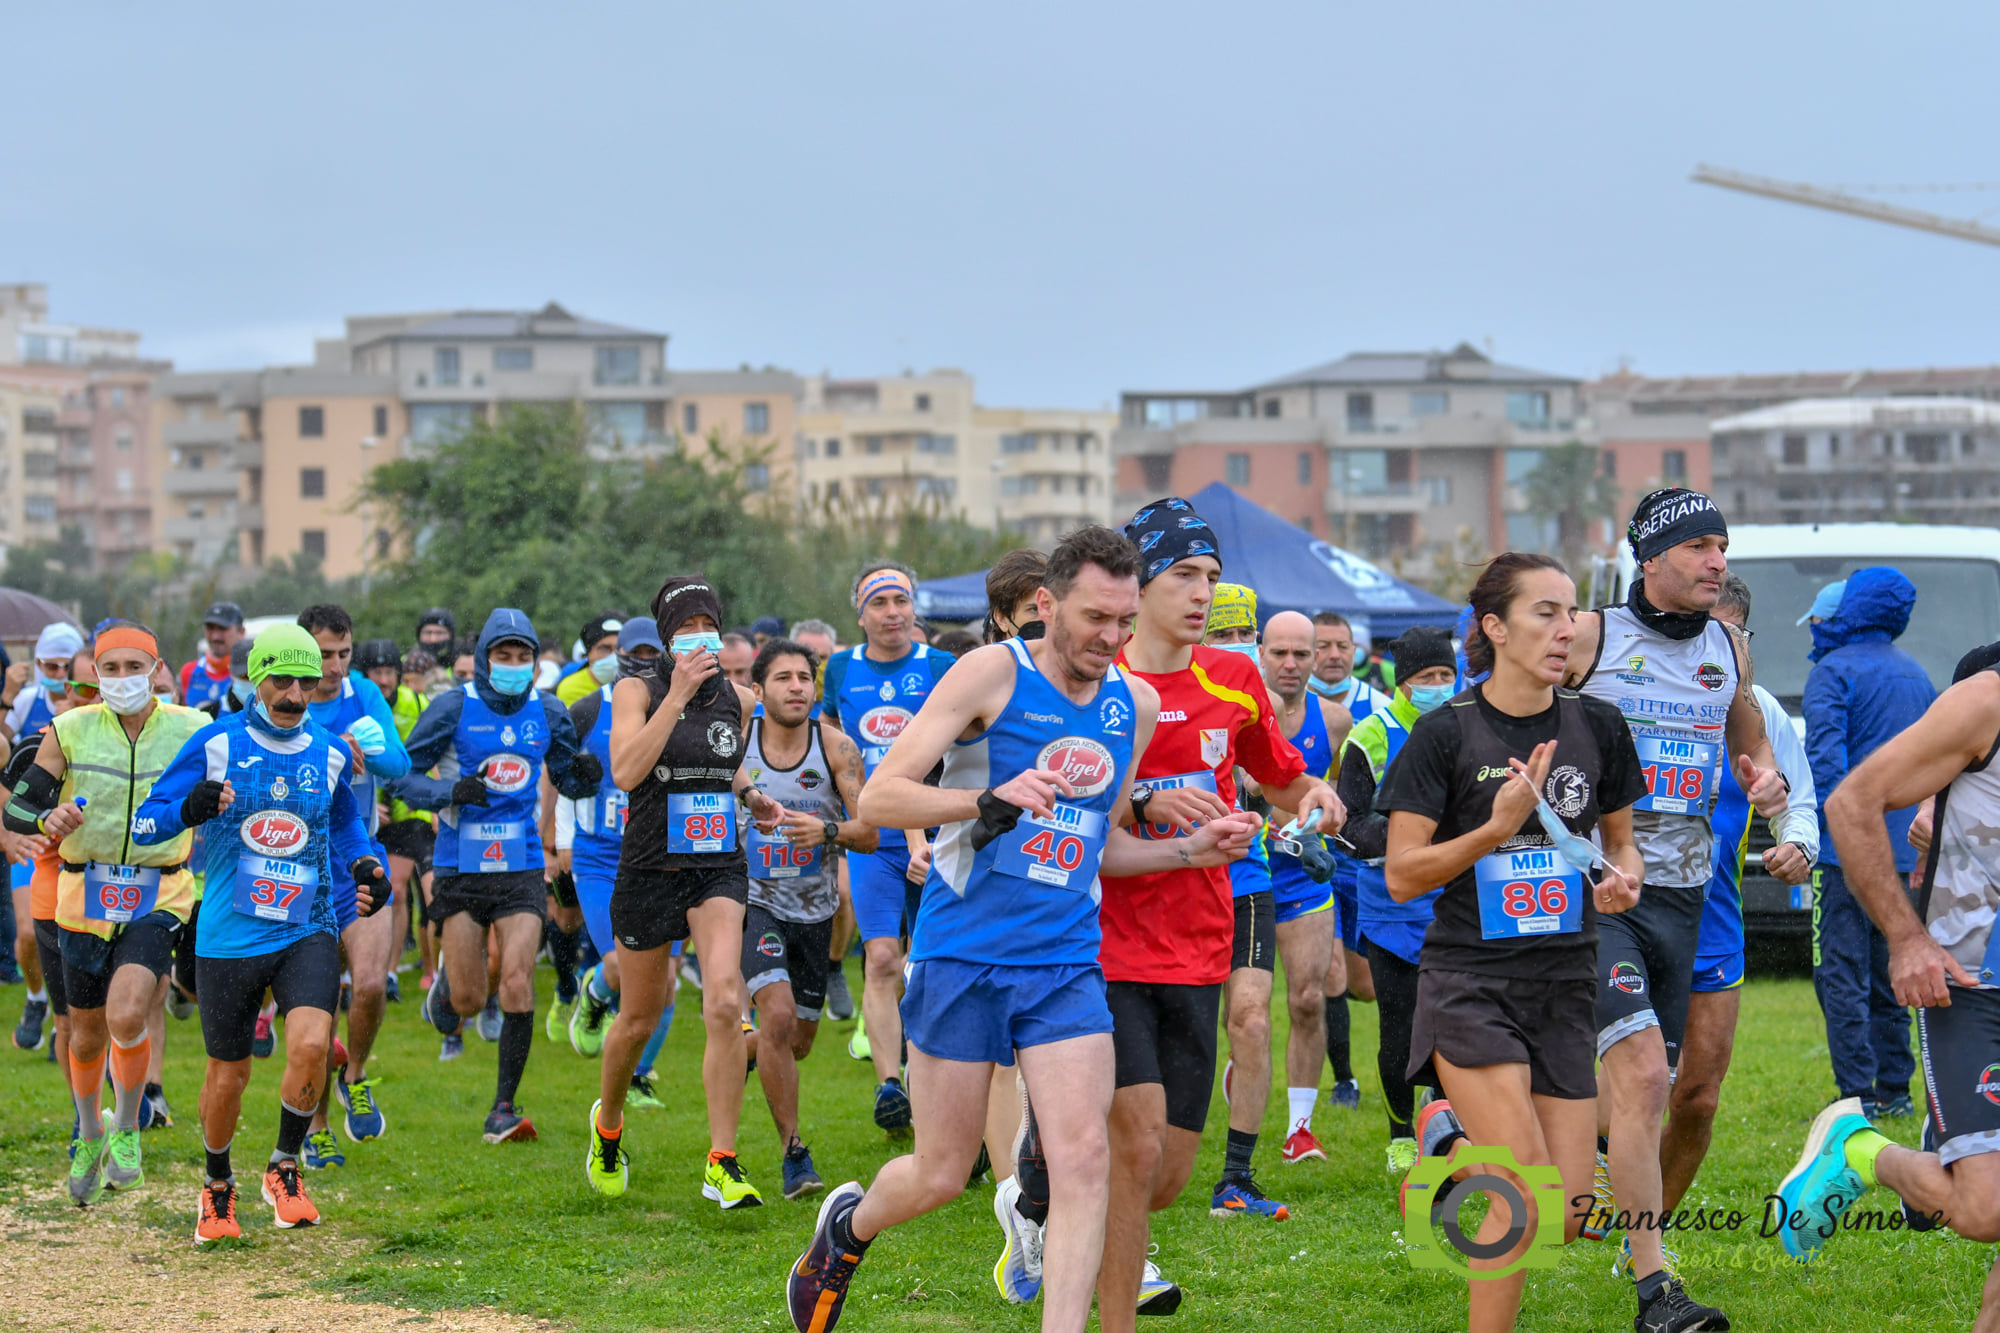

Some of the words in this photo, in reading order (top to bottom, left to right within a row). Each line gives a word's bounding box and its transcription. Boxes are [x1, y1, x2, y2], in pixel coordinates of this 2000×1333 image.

[1692, 673, 1728, 682] EVOLUTION
[1024, 711, 1064, 725] macron
[1157, 709, 1188, 722] ma
[1640, 698, 1695, 717] ITTICA
[1700, 704, 1726, 718] SUD
[871, 712, 908, 736] Sigel
[1630, 725, 1667, 737] AZARA
[1669, 729, 1689, 738] DEL
[1659, 740, 1695, 758] MBI
[486, 759, 524, 784] Sigel
[1057, 746, 1105, 783] Sigel
[1641, 764, 1703, 799] 118
[693, 794, 719, 808] MBI
[252, 817, 298, 846] Sigel
[479, 823, 507, 836] MBI
[684, 813, 727, 840] 88
[483, 840, 505, 861] 4
[757, 844, 814, 867] 116
[1020, 830, 1084, 871] 40
[1511, 852, 1553, 871] MBI
[264, 859, 297, 877] MBI
[99, 883, 142, 911] 69
[249, 878, 302, 909] 37
[1502, 878, 1568, 918] 86
[1811, 869, 1824, 967] GIVOVA
